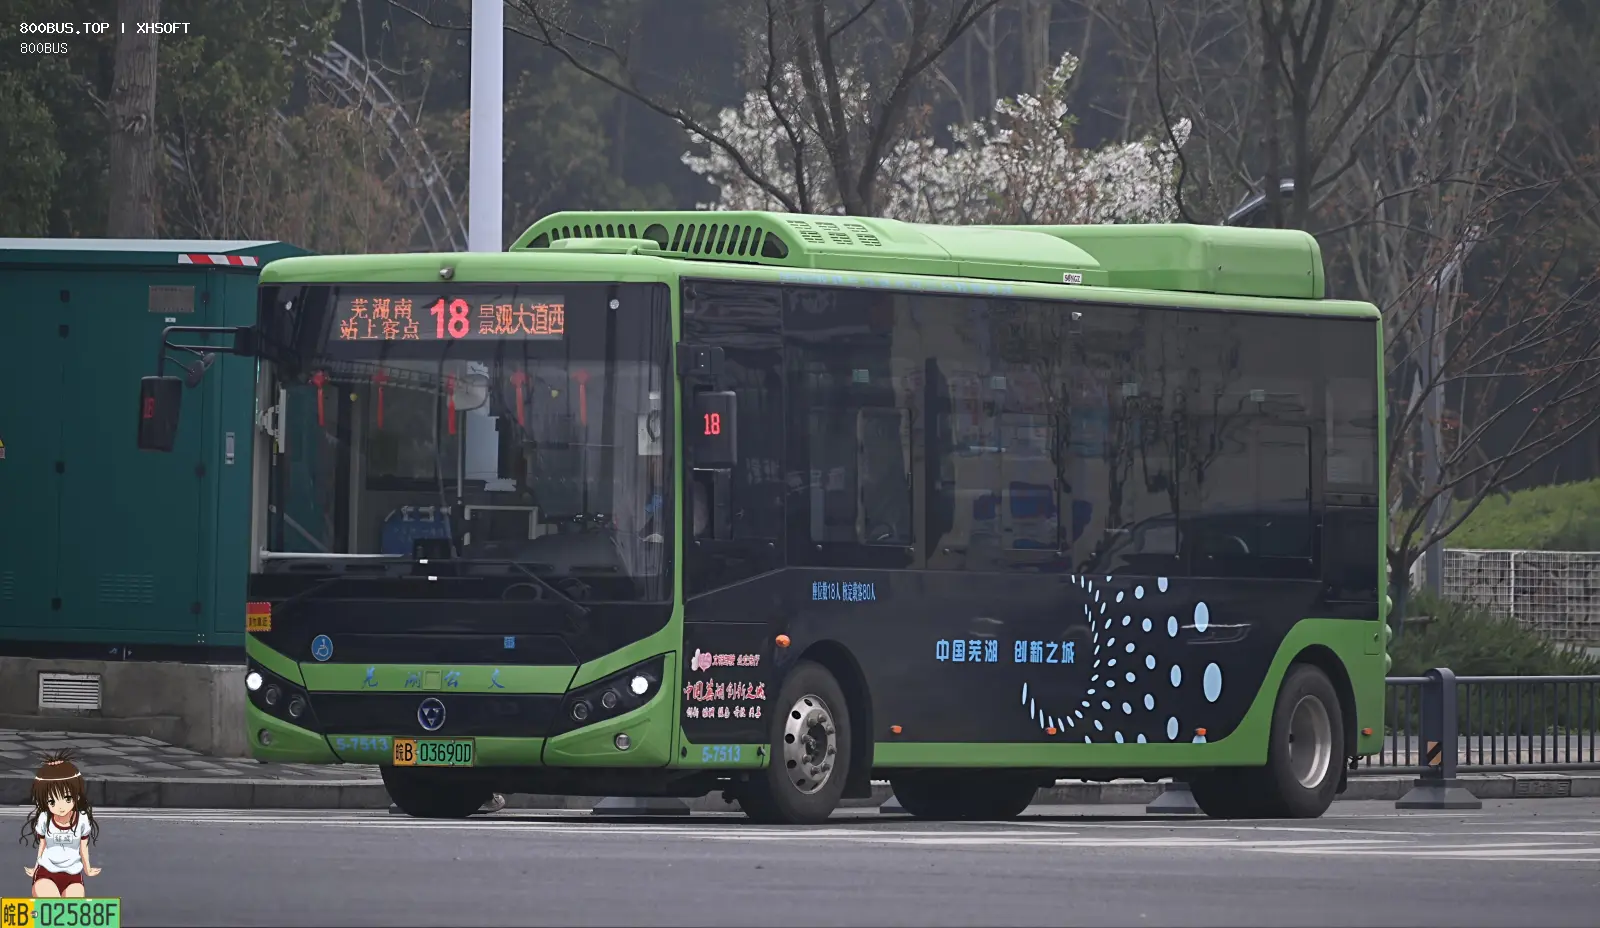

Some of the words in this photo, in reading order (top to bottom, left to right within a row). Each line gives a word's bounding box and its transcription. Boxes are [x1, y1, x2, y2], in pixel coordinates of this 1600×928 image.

[350, 298, 413, 320] 芜湖南
[430, 298, 470, 339] 18
[478, 303, 565, 335] 景观大道西
[340, 319, 420, 340] 站上客点
[703, 413, 721, 435] 18
[936, 639, 998, 662] 中国芜湖
[1014, 640, 1075, 664] 创新之城
[336, 737, 390, 751] 5-7513
[702, 745, 741, 762] 5-7513
